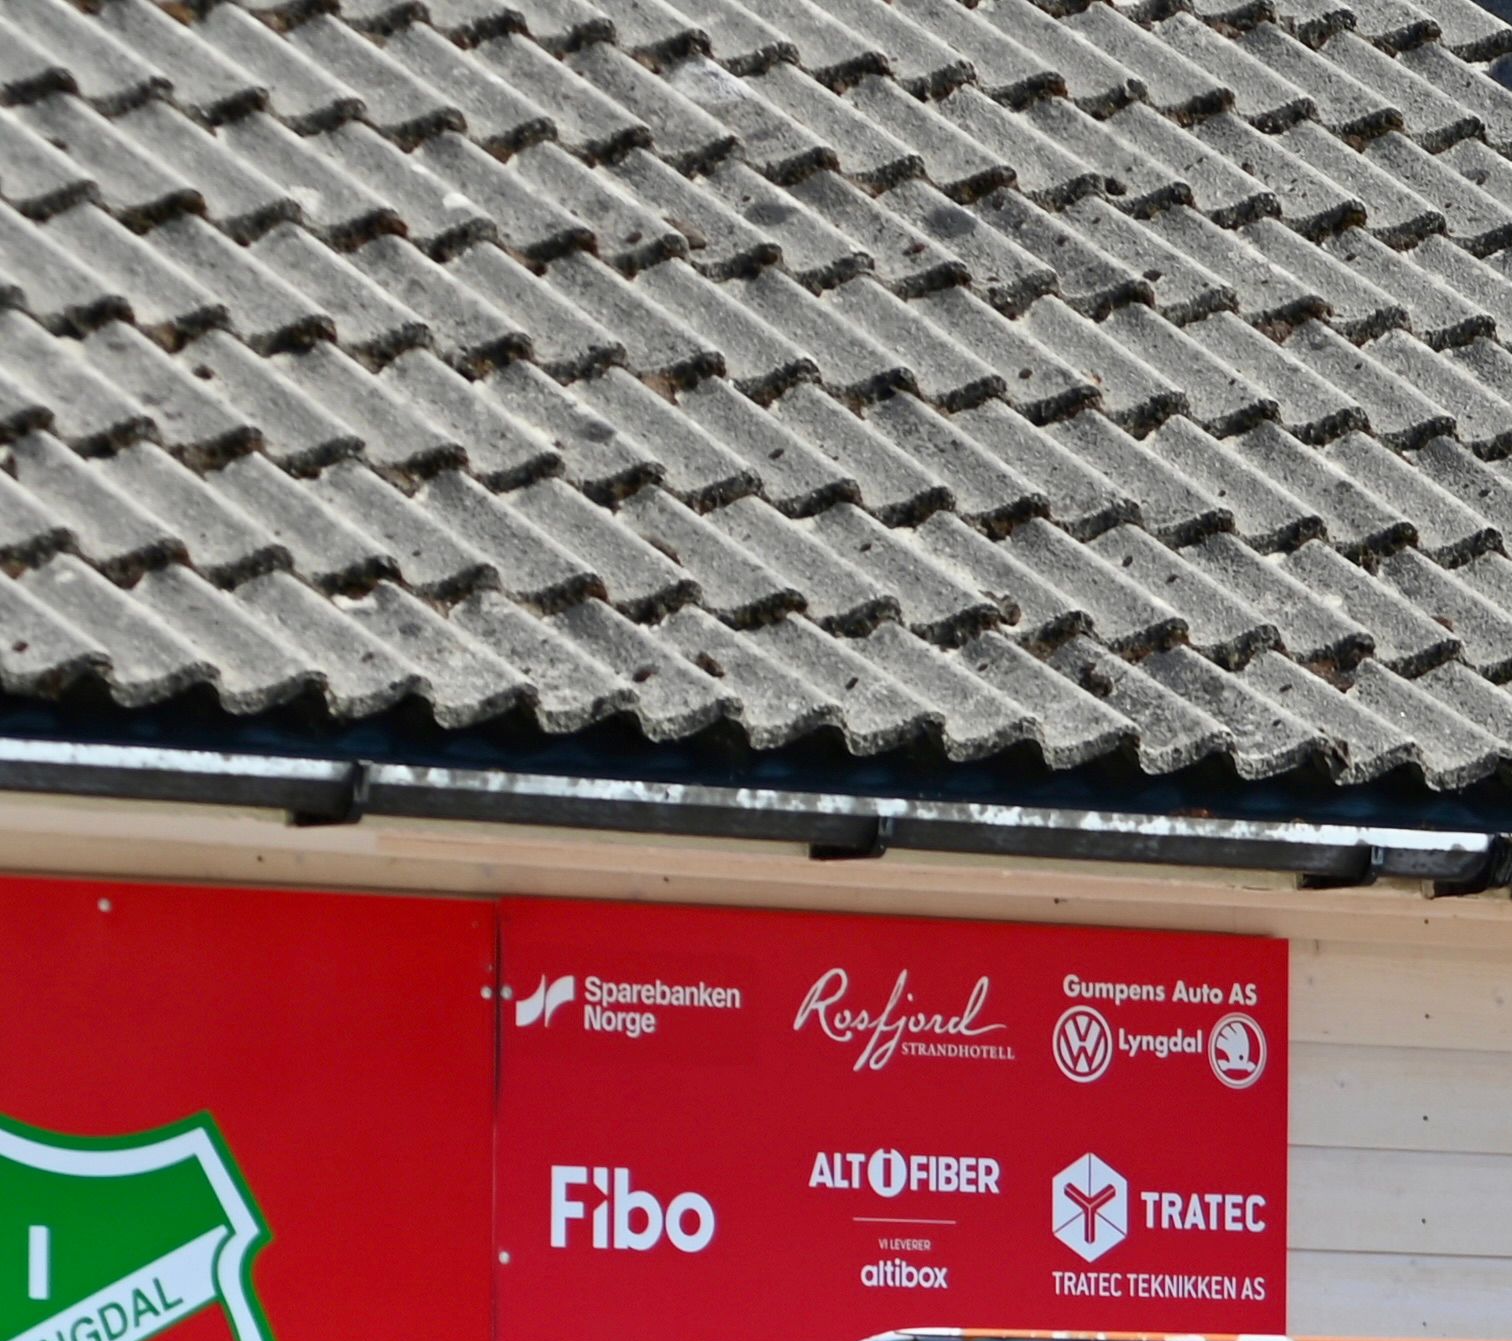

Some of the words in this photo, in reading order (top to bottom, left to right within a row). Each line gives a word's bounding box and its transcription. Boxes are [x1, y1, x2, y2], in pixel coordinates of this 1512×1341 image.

[584, 977, 741, 1009] Sparebanken
[1063, 974, 1165, 1006] Gumpens
[1172, 980, 1223, 1005] Auto
[1229, 983, 1257, 1006] AS
[584, 1005, 657, 1037] Norge
[794, 968, 1007, 1071] Rosfjord
[901, 1041, 1015, 1061] STRANDHOTELL
[1119, 1028, 1202, 1059] Lyngdal
[551, 1165, 715, 1252] Fibo
[1141, 1192, 1266, 1232] TRATEC
[890, 1239, 931, 1251] LEVERER
[861, 1258, 948, 1289] altibox
[1052, 1271, 1122, 1296] TRATEC
[1127, 1273, 1236, 1299] TEKNIKKEN
[1241, 1277, 1265, 1300] AS
